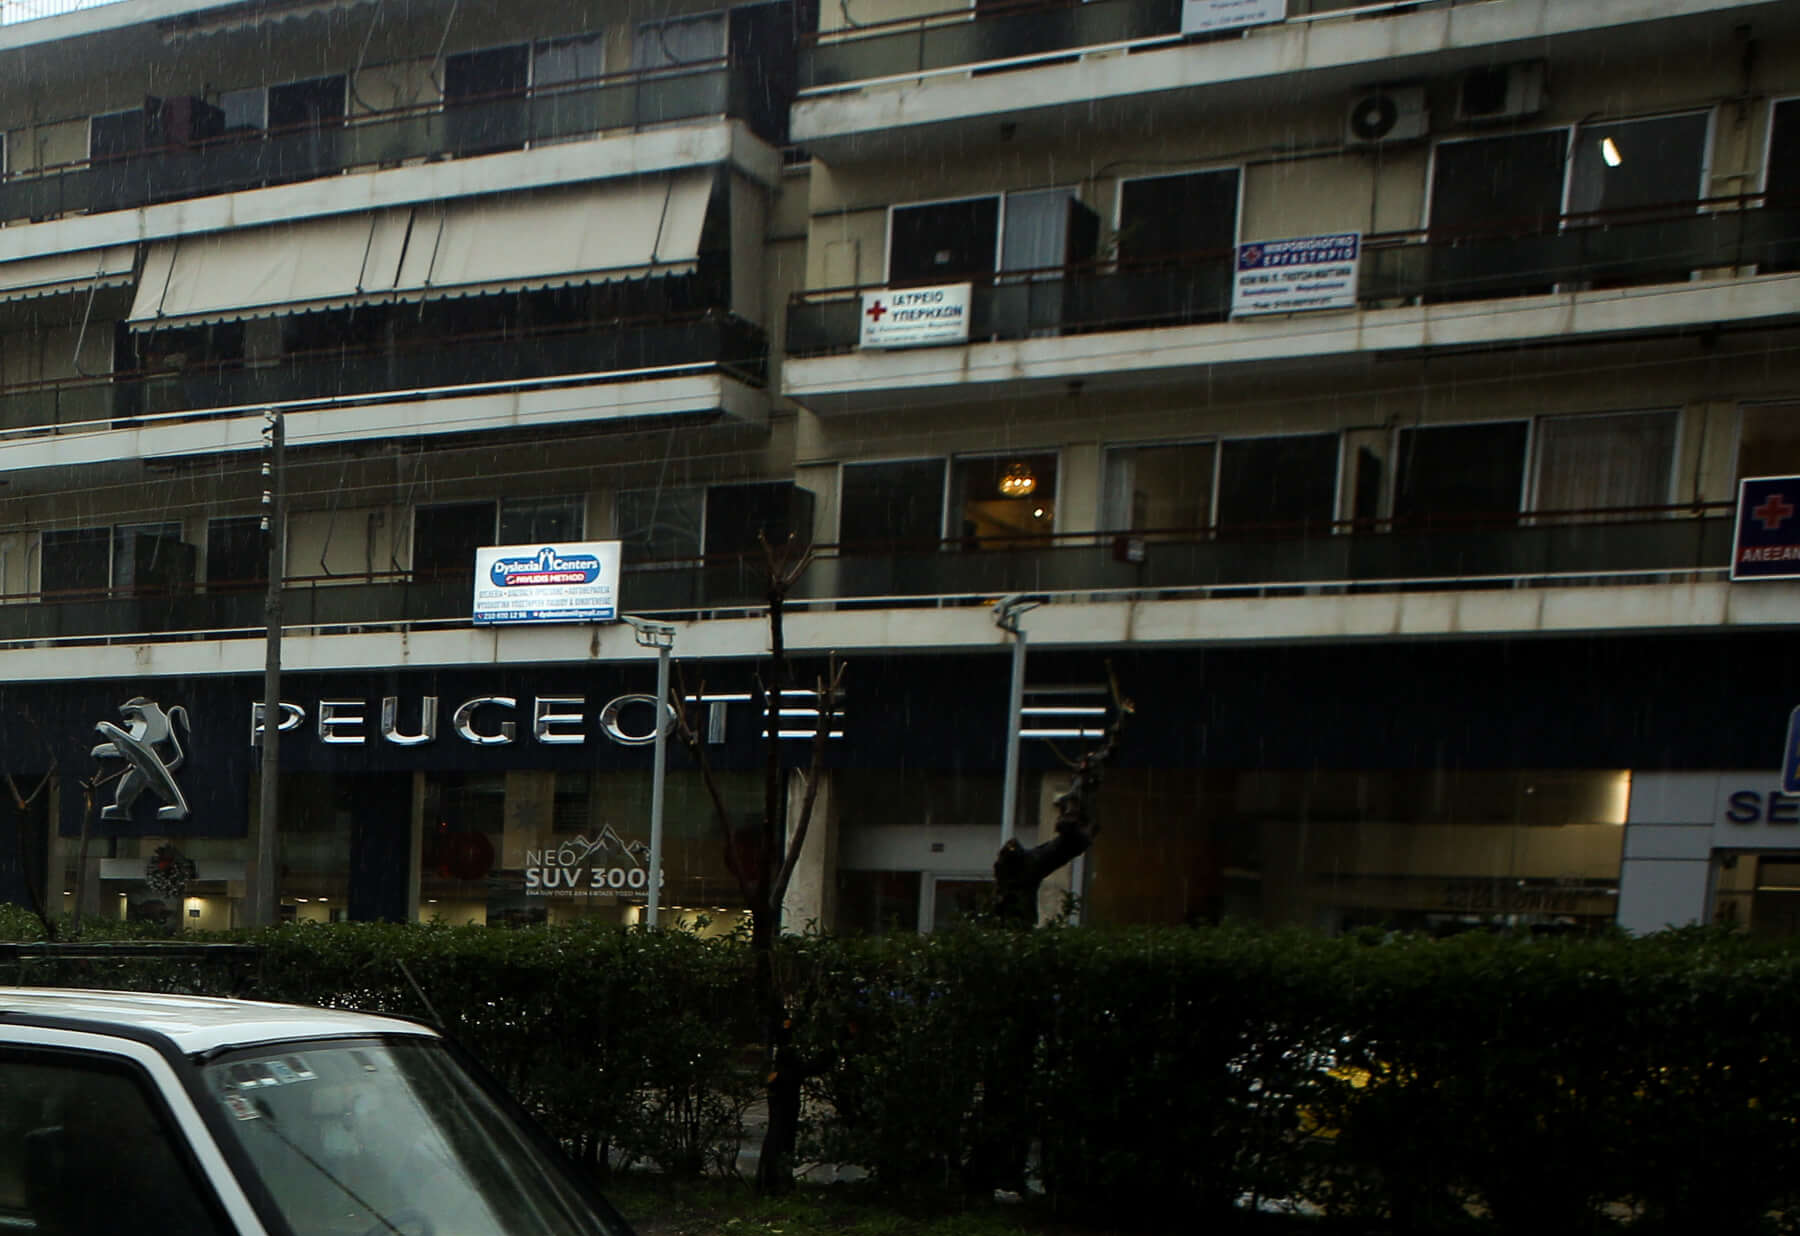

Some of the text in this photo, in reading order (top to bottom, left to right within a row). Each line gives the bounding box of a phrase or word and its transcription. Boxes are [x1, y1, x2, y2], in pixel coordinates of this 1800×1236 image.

[892, 290, 944, 306] ΙΑΤΡΕΙΟ
[891, 304, 963, 321] ΥΠΕΡΗΧΩΝ
[495, 558, 598, 575] Dyslexia Centers
[253, 693, 752, 747] PEUGEOT
[526, 849, 576, 867] ΝΕΟ
[525, 868, 582, 888] SUV
